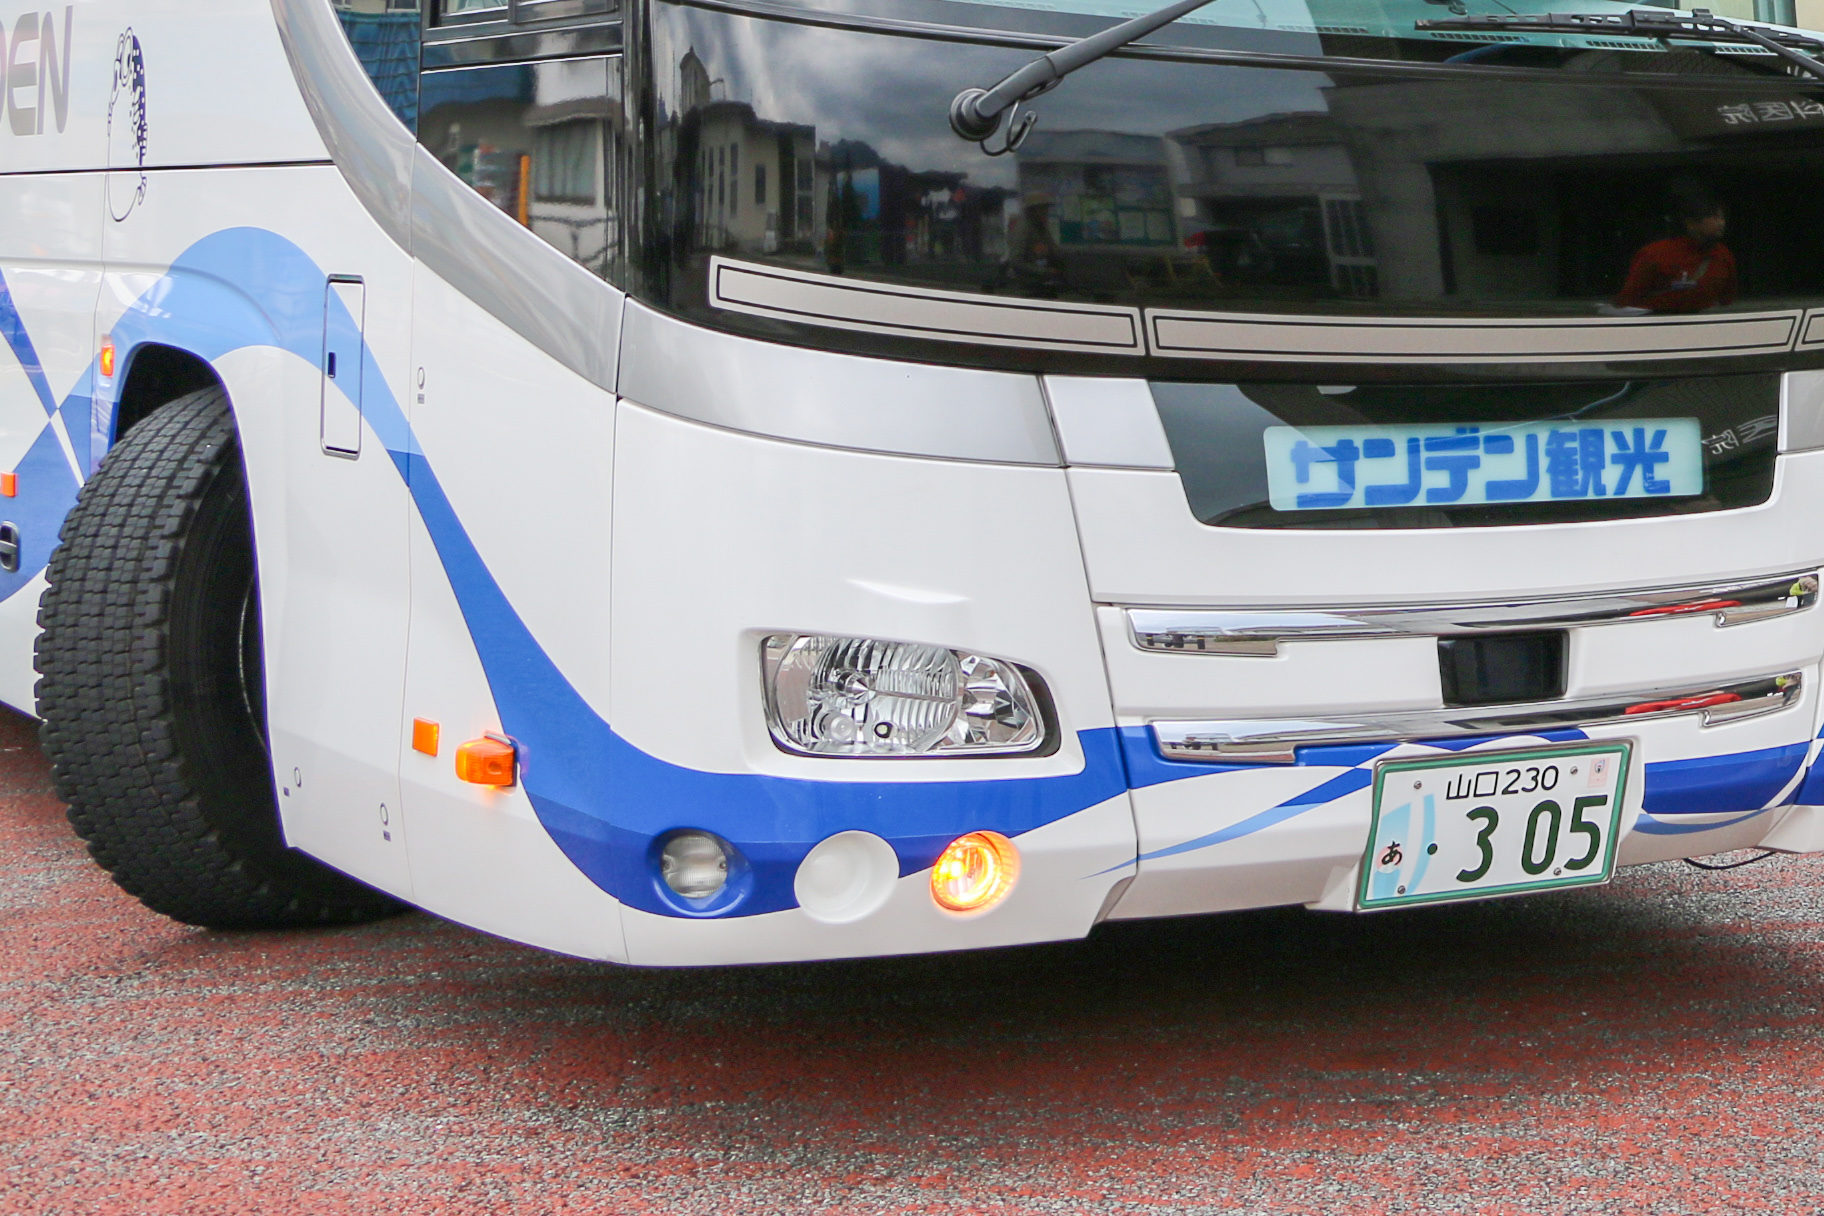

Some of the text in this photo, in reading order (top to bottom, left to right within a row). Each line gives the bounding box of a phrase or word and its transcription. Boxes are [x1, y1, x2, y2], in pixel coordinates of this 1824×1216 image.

[0, 5, 73, 136] EN
[1289, 427, 1671, 508] サンデン観光
[1381, 840, 1403, 866] あ
